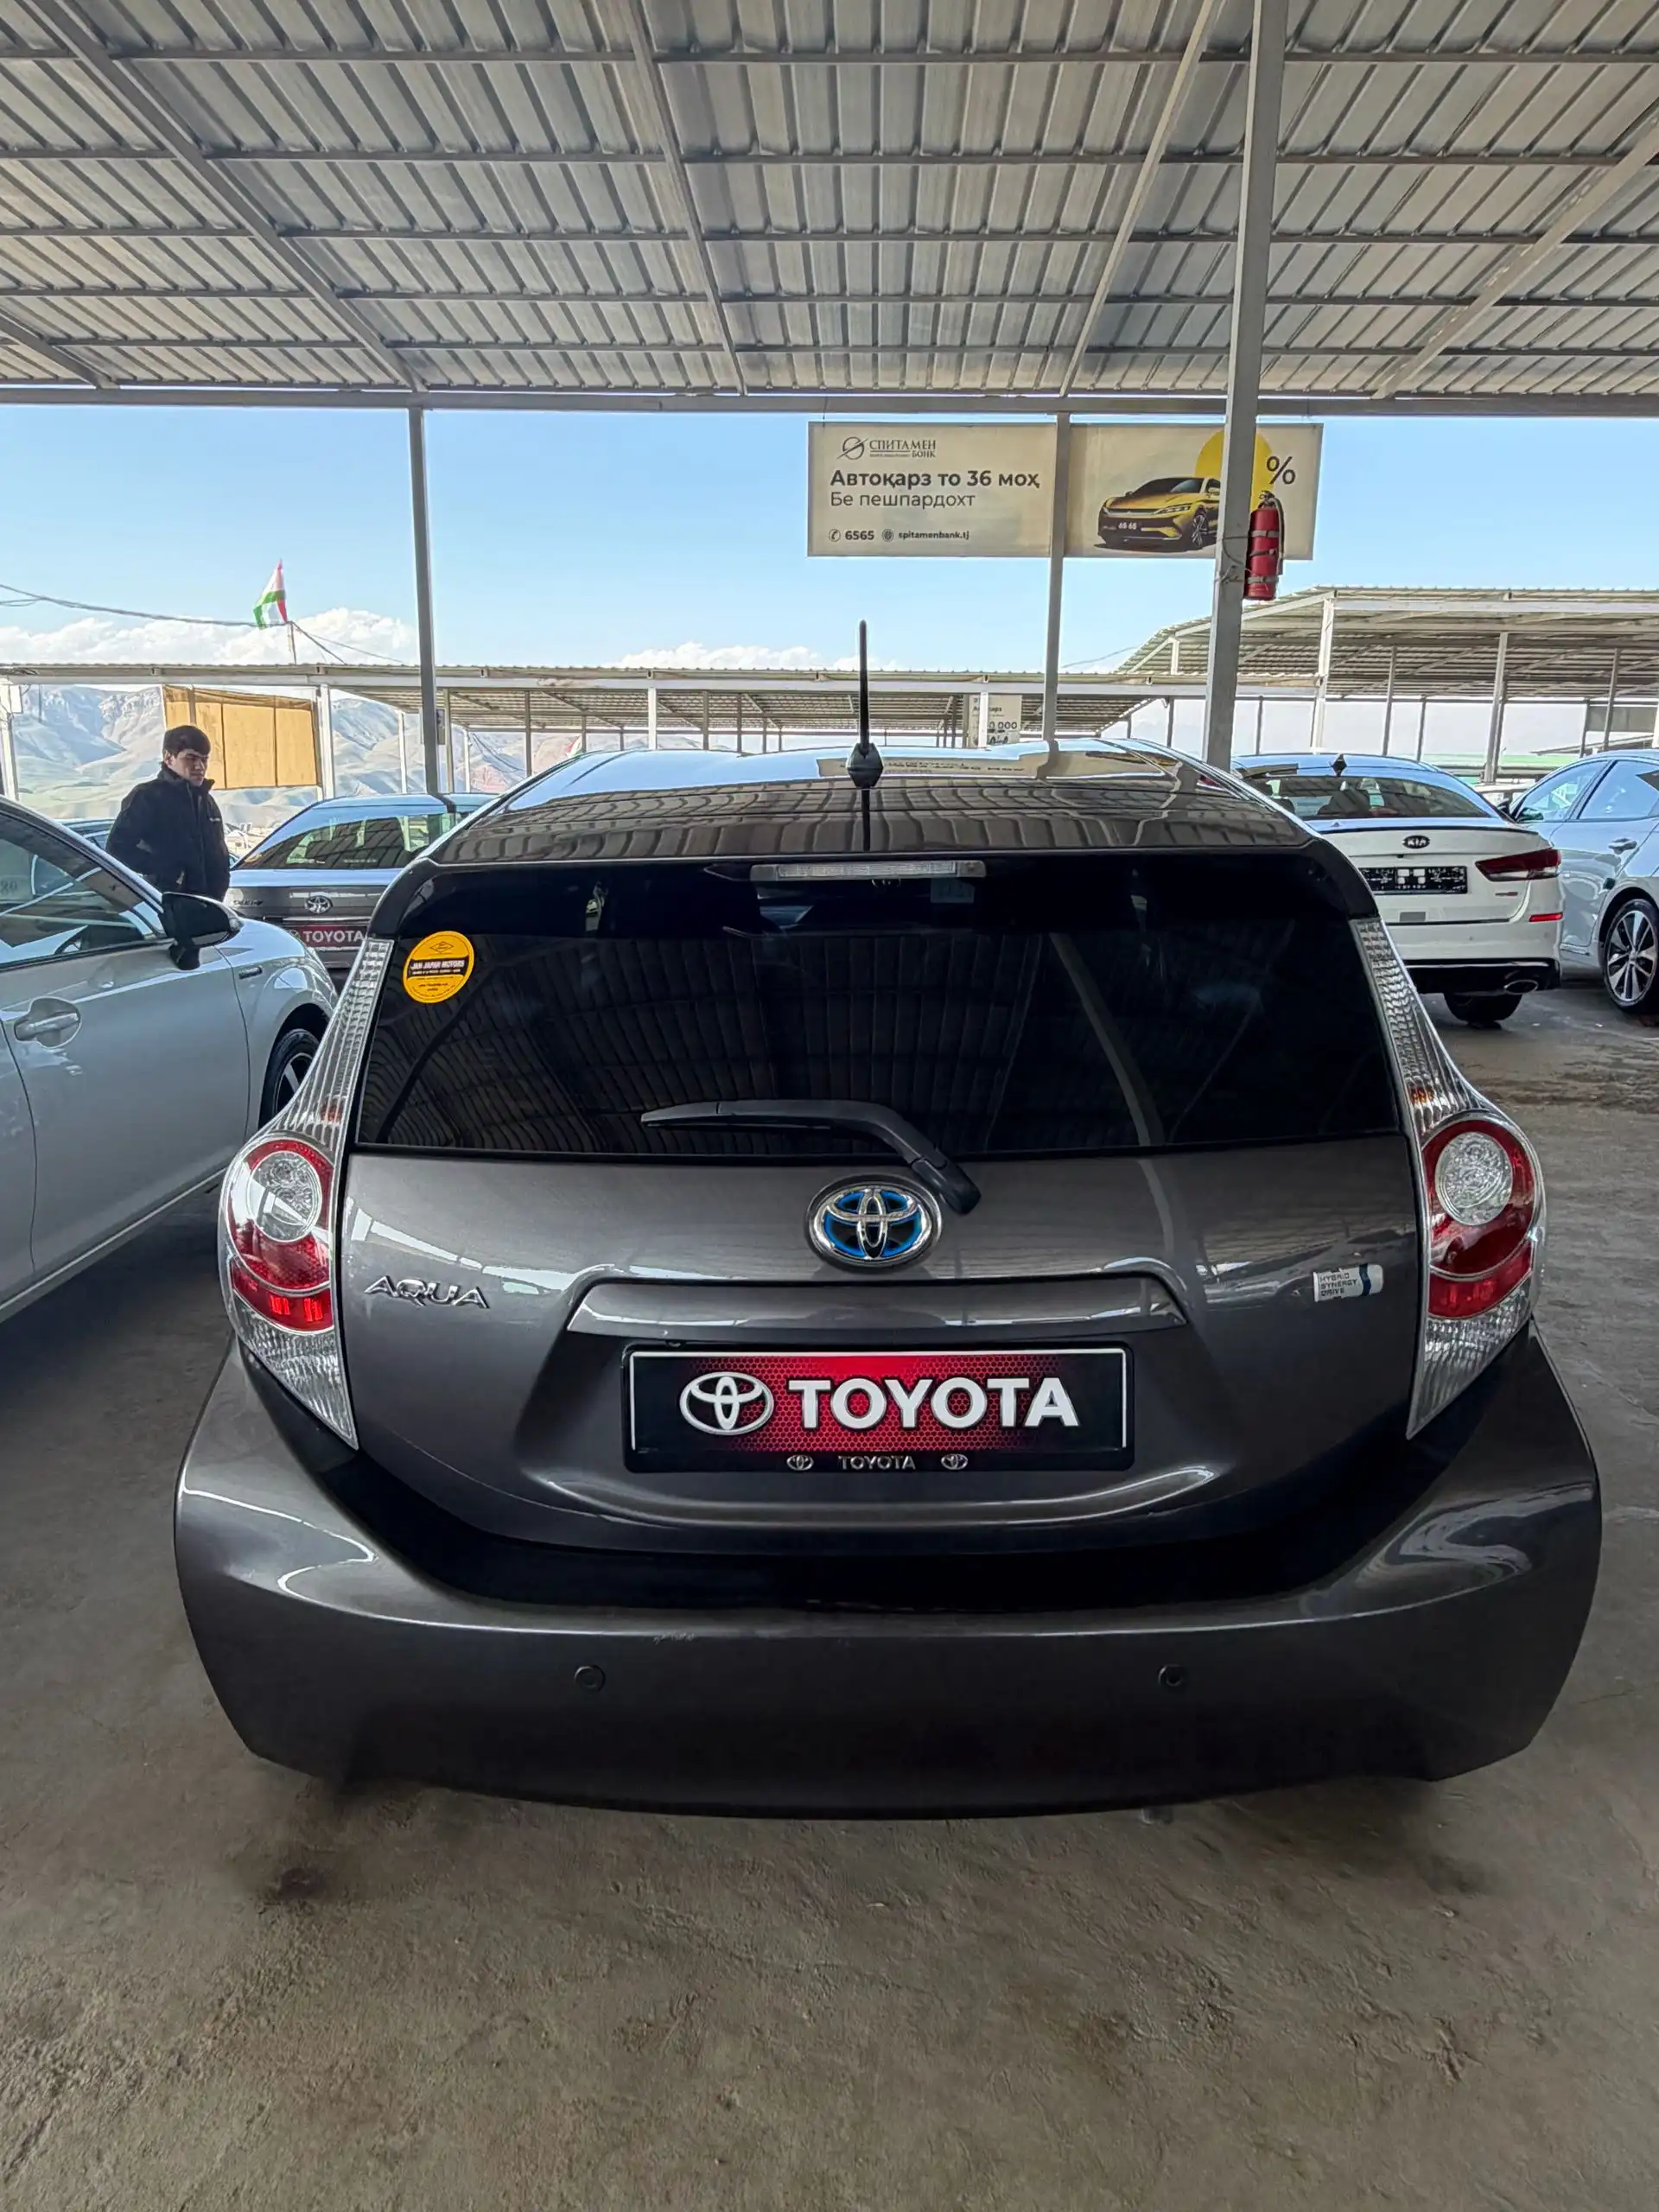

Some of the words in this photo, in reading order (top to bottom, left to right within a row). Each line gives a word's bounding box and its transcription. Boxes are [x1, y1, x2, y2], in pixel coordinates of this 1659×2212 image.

[869, 439, 936, 450] СПИТАМЕН
[912, 449, 936, 458] БОНК
[830, 469, 931, 490] Автоқарз
[938, 473, 961, 486] то
[967, 470, 992, 486] 36
[830, 492, 854, 506] Бе
[859, 493, 976, 510] пешпардохт
[844, 531, 875, 541] 6565
[898, 531, 969, 541] spitamenbank.tj
[302, 930, 364, 943] TOYOTA
[364, 1275, 490, 1309] AQUA
[787, 1377, 1079, 1430] TOYOTA
[838, 1455, 916, 1471] TOYOTA
